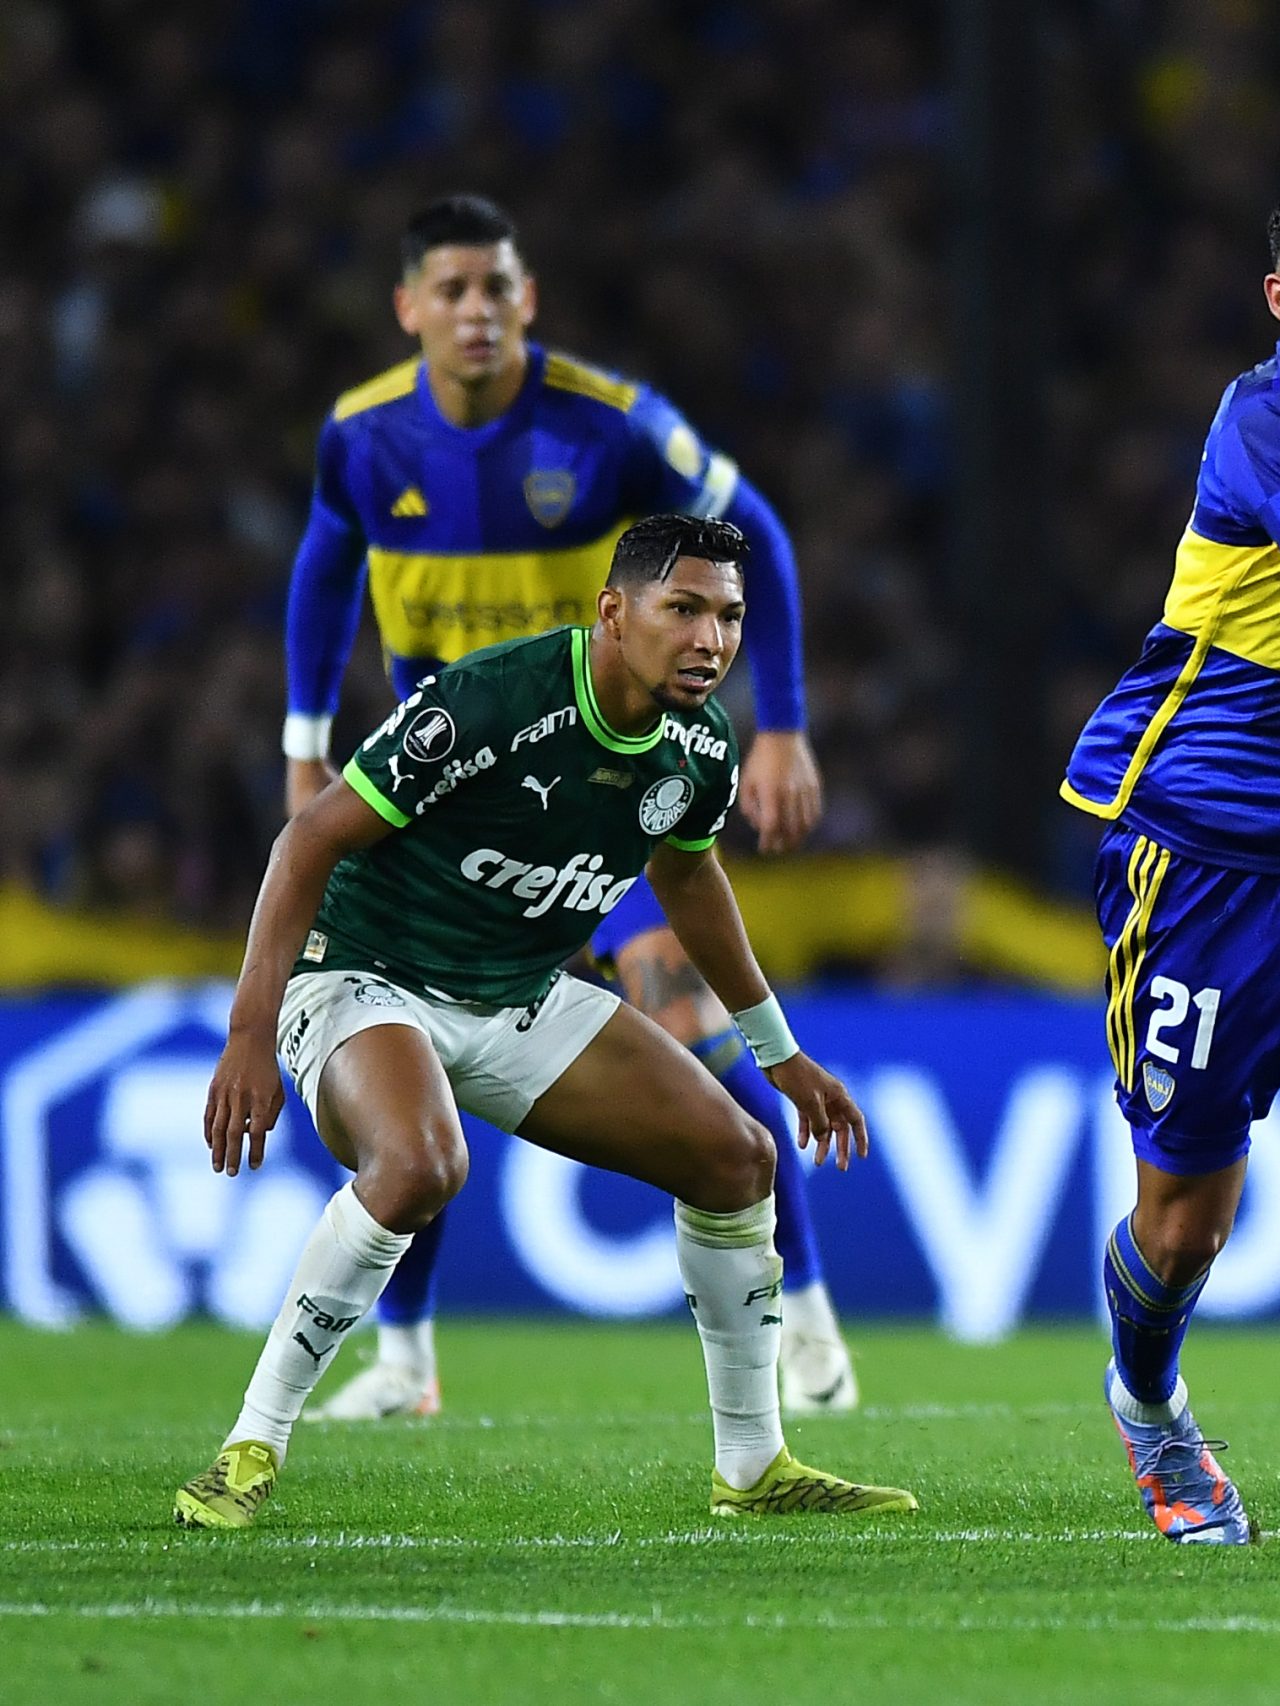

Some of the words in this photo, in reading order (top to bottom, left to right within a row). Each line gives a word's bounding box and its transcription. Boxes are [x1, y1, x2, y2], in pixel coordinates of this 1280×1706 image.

[415, 745, 498, 816] crefisa
[642, 798, 687, 831] PALMEIRAS
[1145, 975, 1222, 1070] 21
